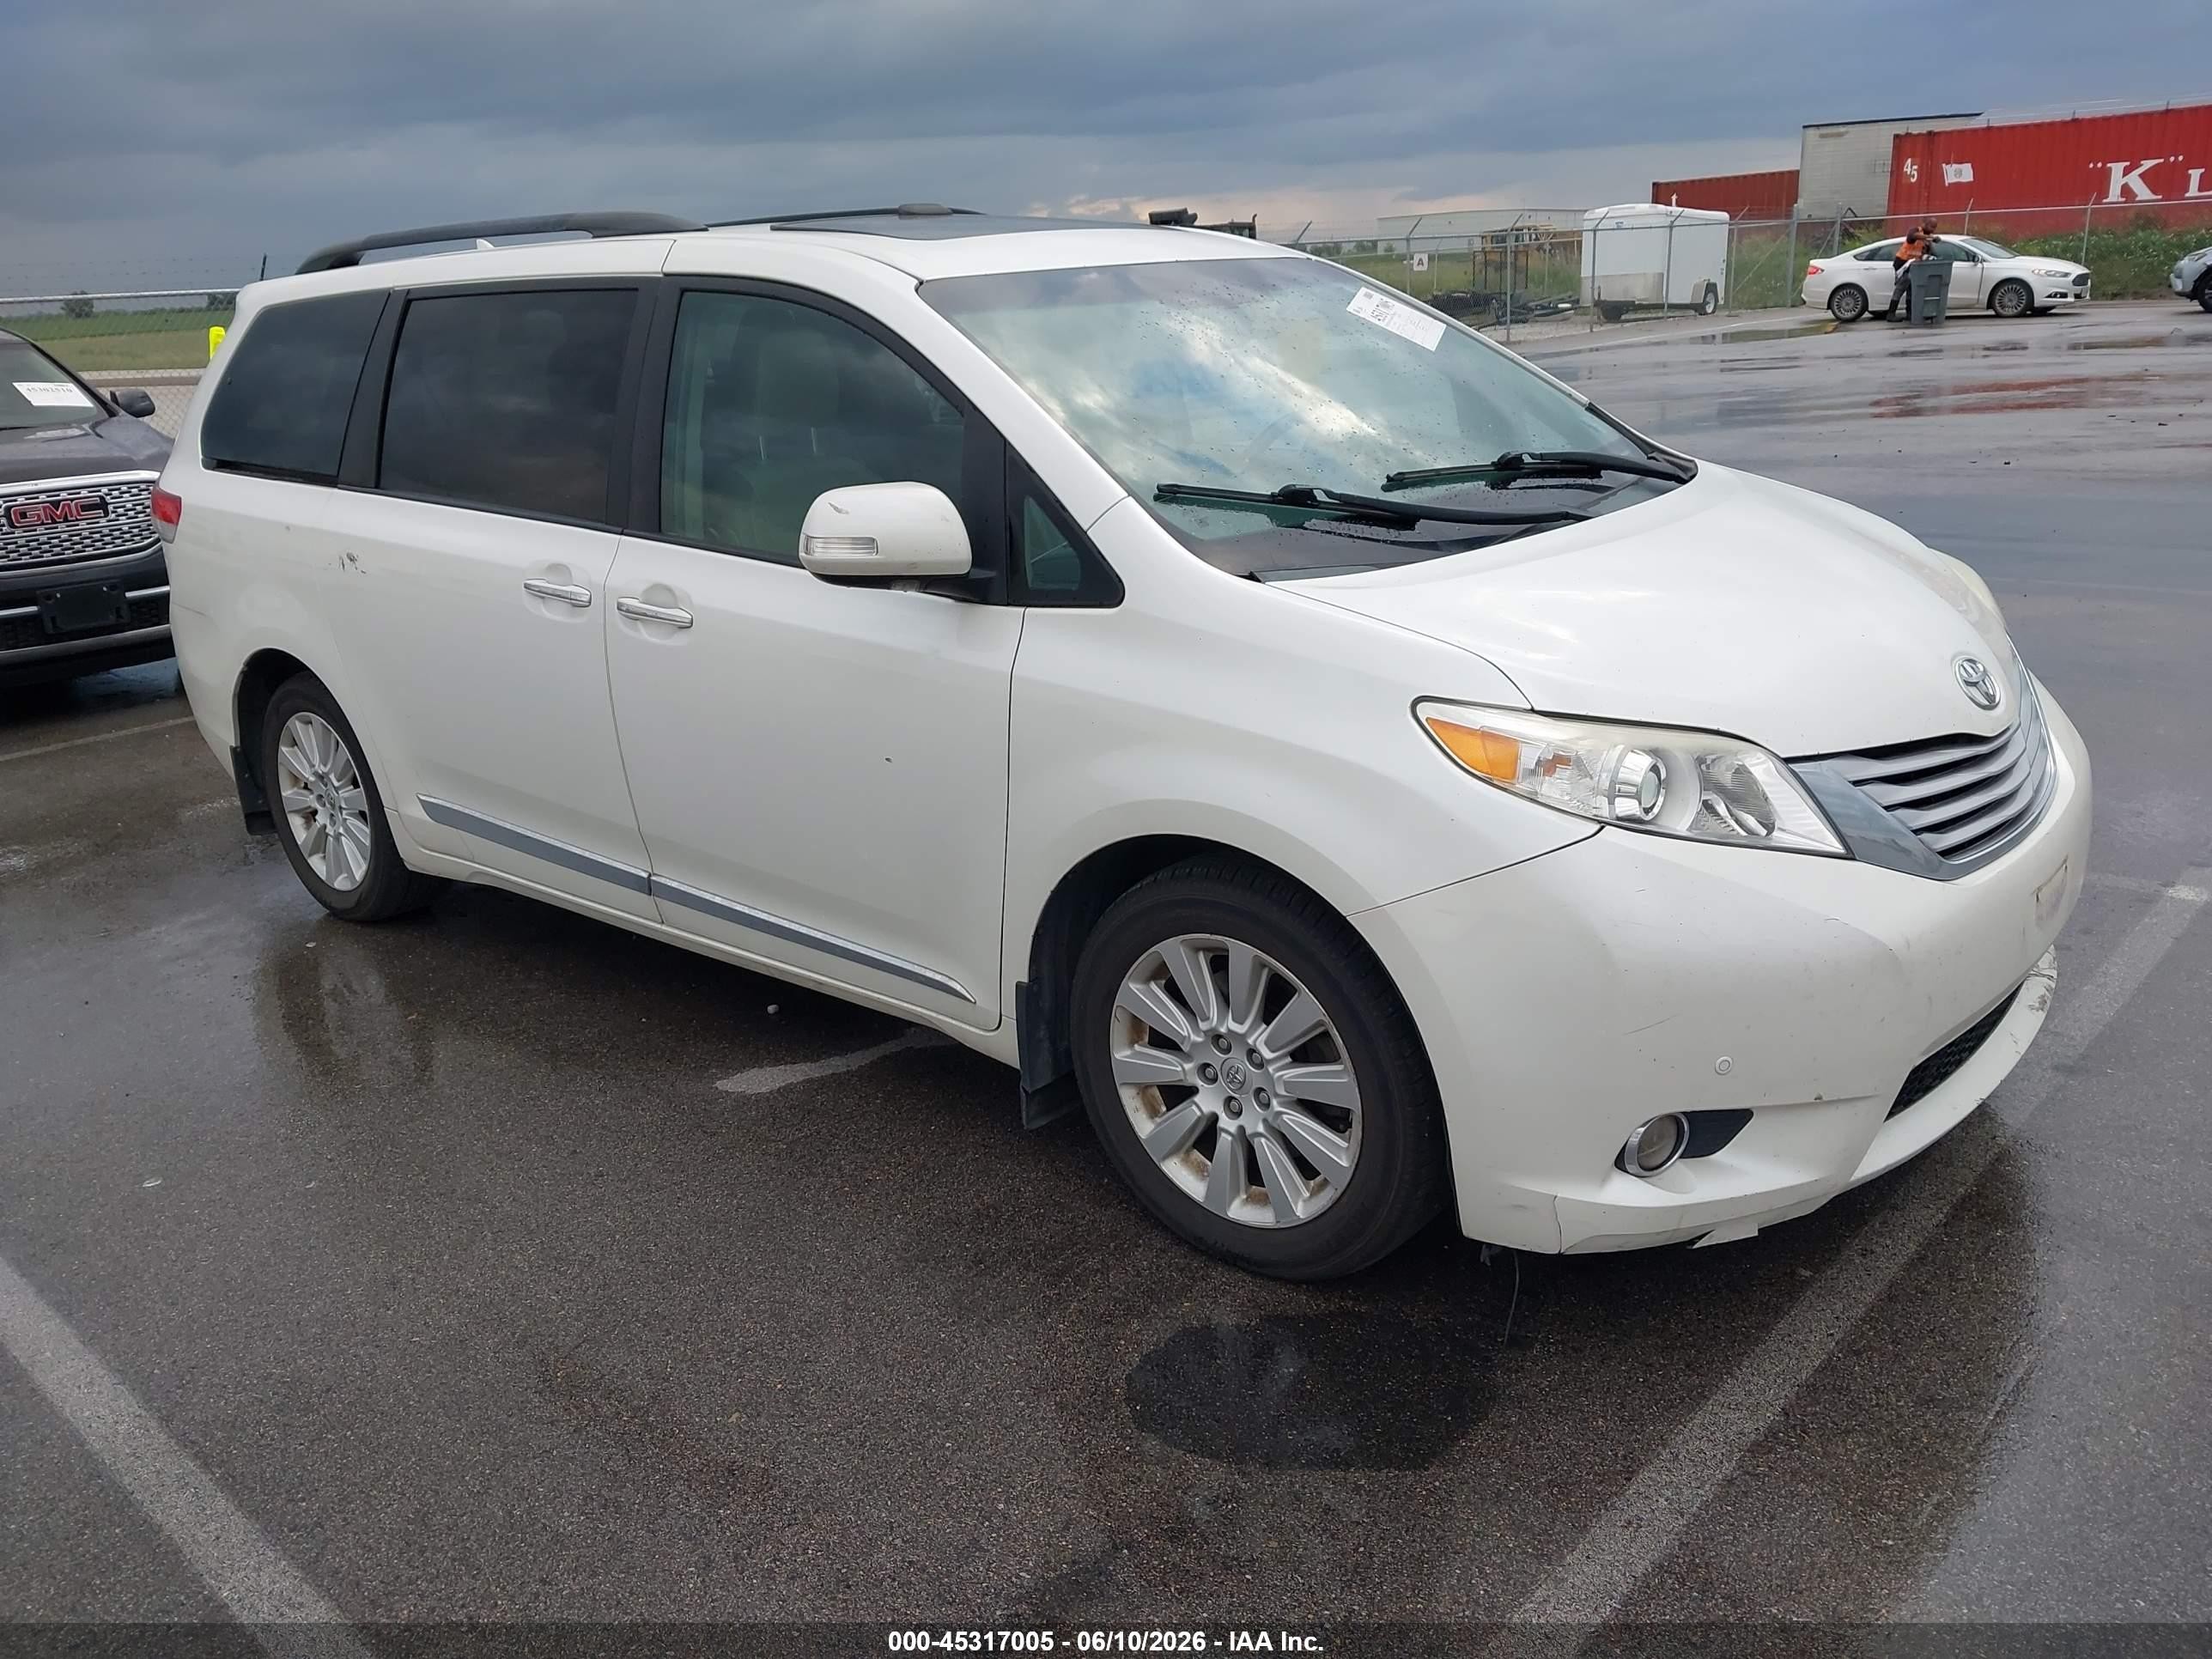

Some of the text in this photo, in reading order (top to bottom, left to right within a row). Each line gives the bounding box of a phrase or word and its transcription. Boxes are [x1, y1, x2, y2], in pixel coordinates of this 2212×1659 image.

[1903, 157, 1918, 183] 45
[1417, 258, 1425, 267] A
[10, 497, 105, 527] GMC
